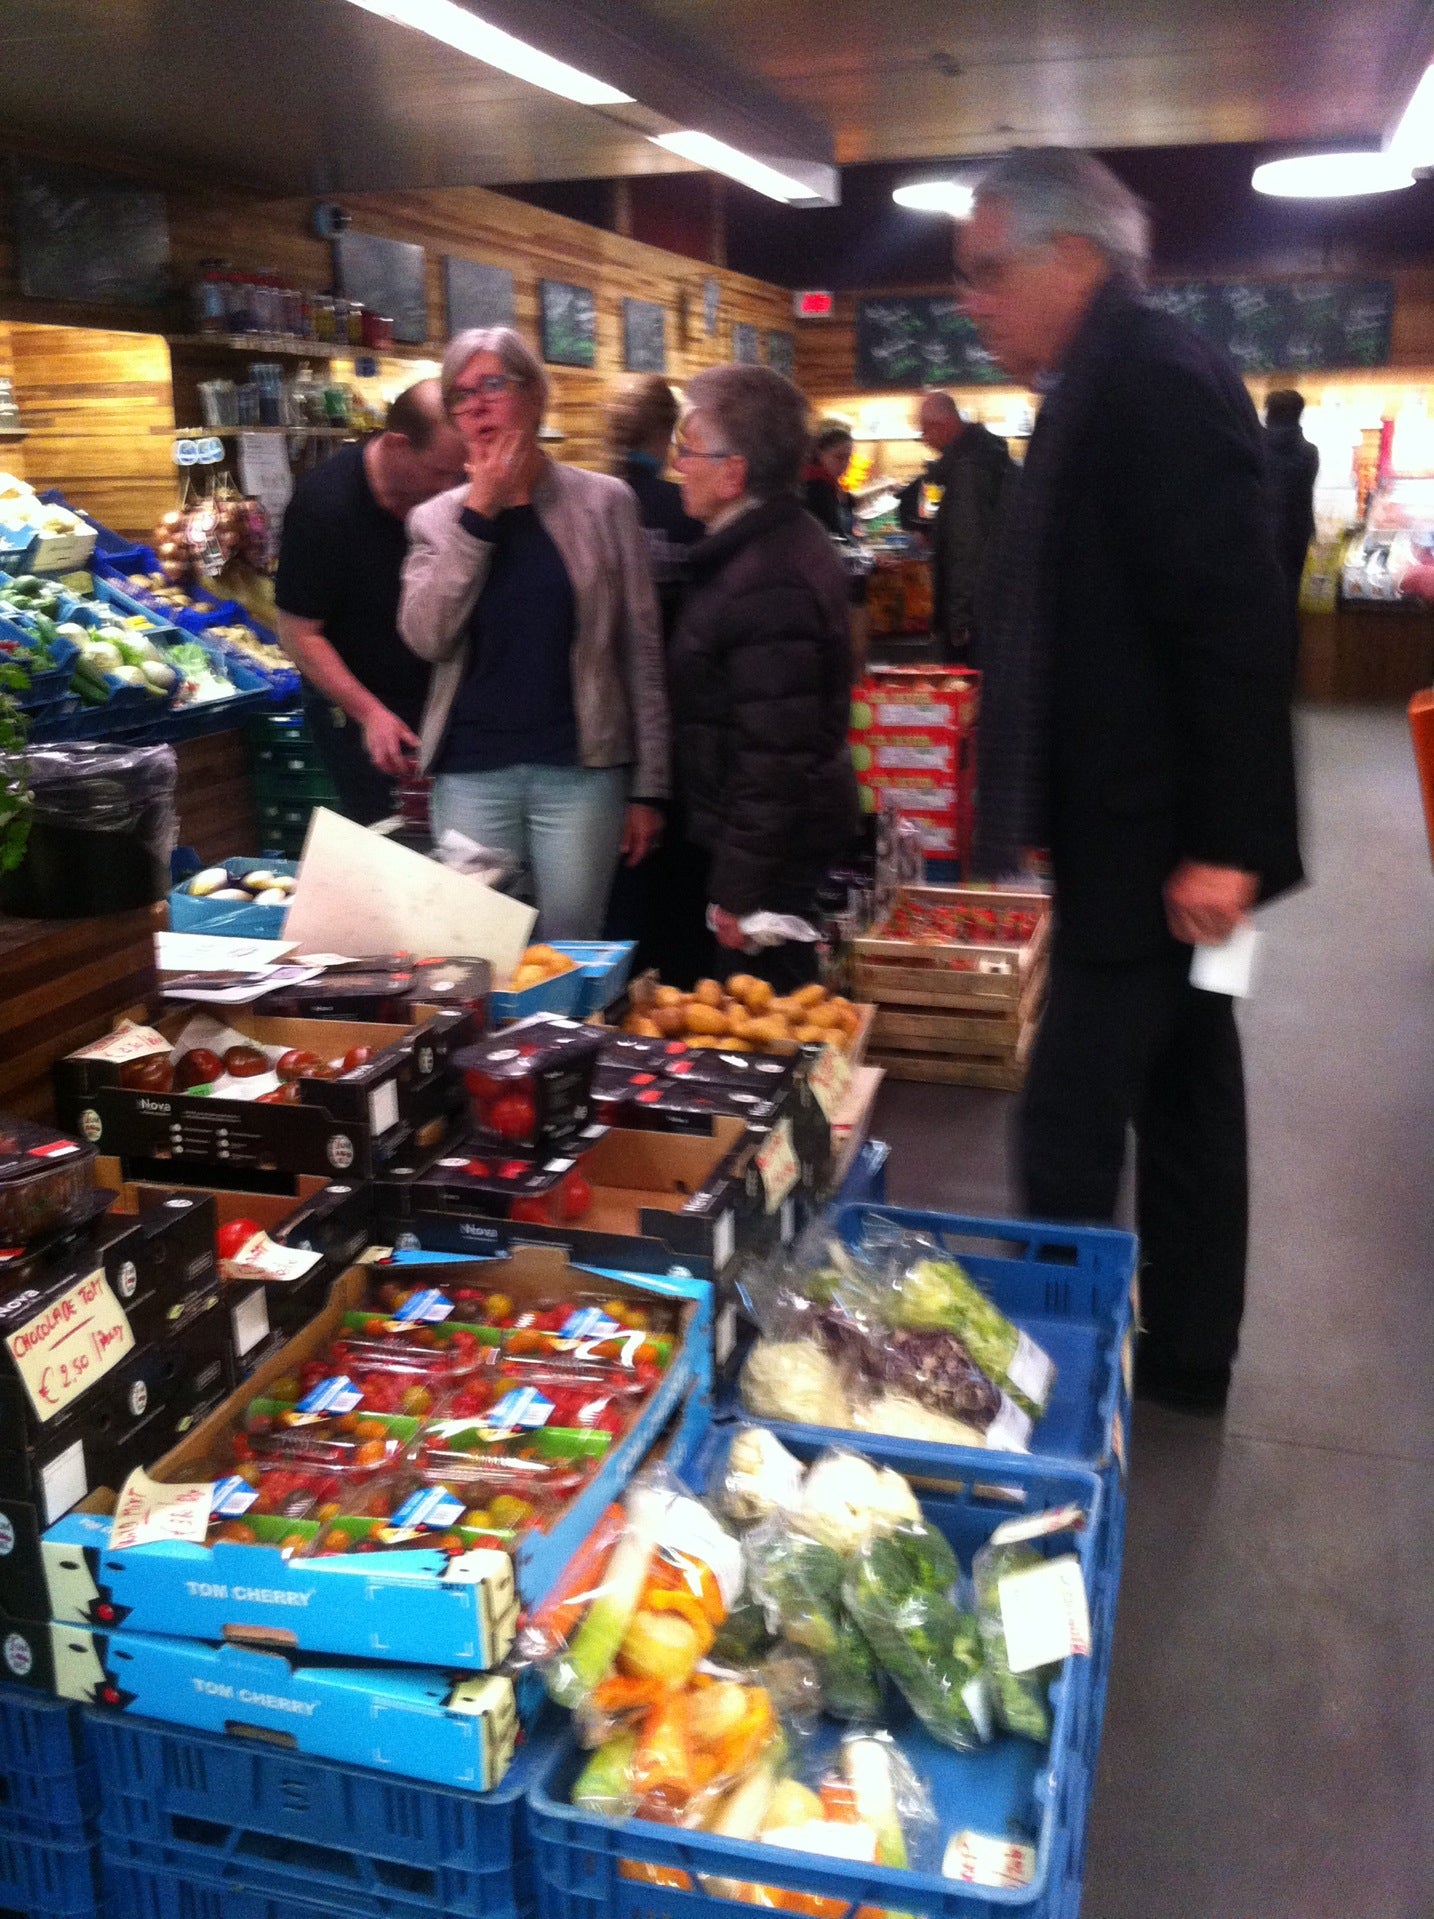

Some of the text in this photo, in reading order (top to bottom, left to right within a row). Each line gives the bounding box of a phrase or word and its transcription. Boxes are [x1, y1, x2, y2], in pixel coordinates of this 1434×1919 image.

[138, 1098, 172, 1112] Nova
[185, 1581, 317, 1607] TOM CHERRY
[193, 1677, 322, 1716] TOM CHERRY
